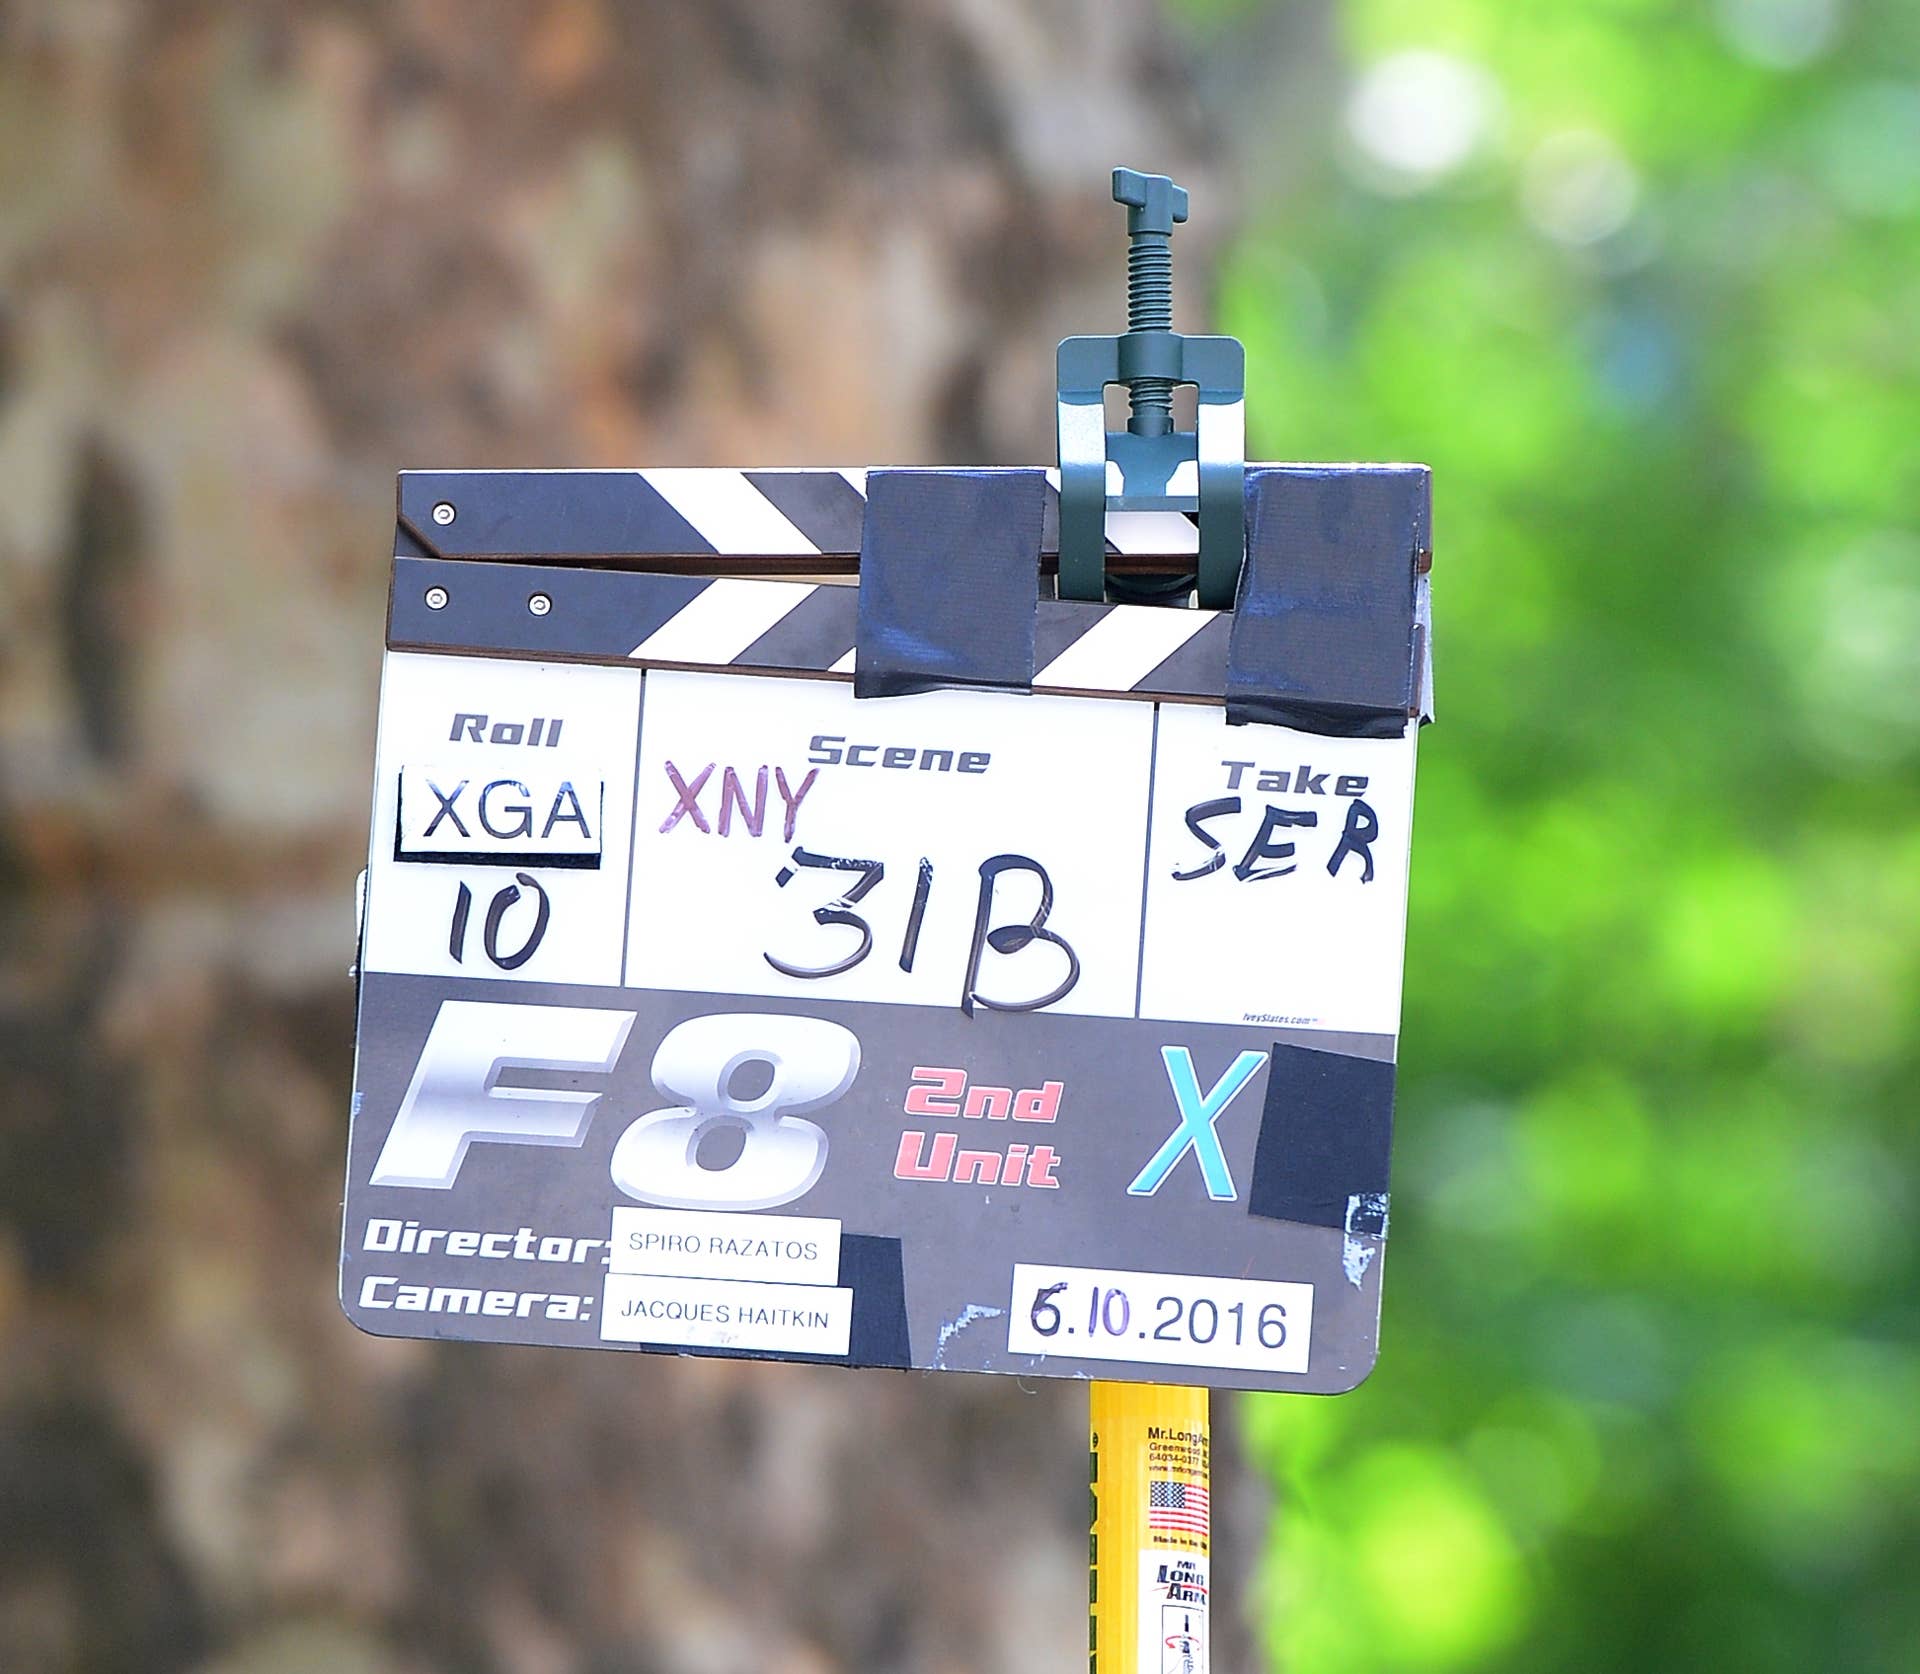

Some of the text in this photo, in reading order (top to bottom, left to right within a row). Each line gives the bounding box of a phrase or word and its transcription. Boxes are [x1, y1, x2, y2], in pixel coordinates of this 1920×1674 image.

[449, 713, 563, 747] Roll
[807, 735, 992, 774] Scene
[658, 760, 820, 843] XNY
[1221, 761, 1369, 797] Take
[422, 779, 592, 840] XGA
[1171, 797, 1380, 884] SER
[448, 871, 551, 971] 10
[368, 1000, 862, 1211] F8
[904, 1065, 1064, 1123] 2nd
[1126, 1045, 1270, 1201] X
[893, 1130, 1061, 1189] Unit
[628, 1231, 819, 1261] SPIRO RAZATOS
[360, 1275, 594, 1322] Camera:
[620, 1299, 829, 1329] JACQUES HAITKIN
[1030, 1281, 1288, 1349] 6.10.2016
